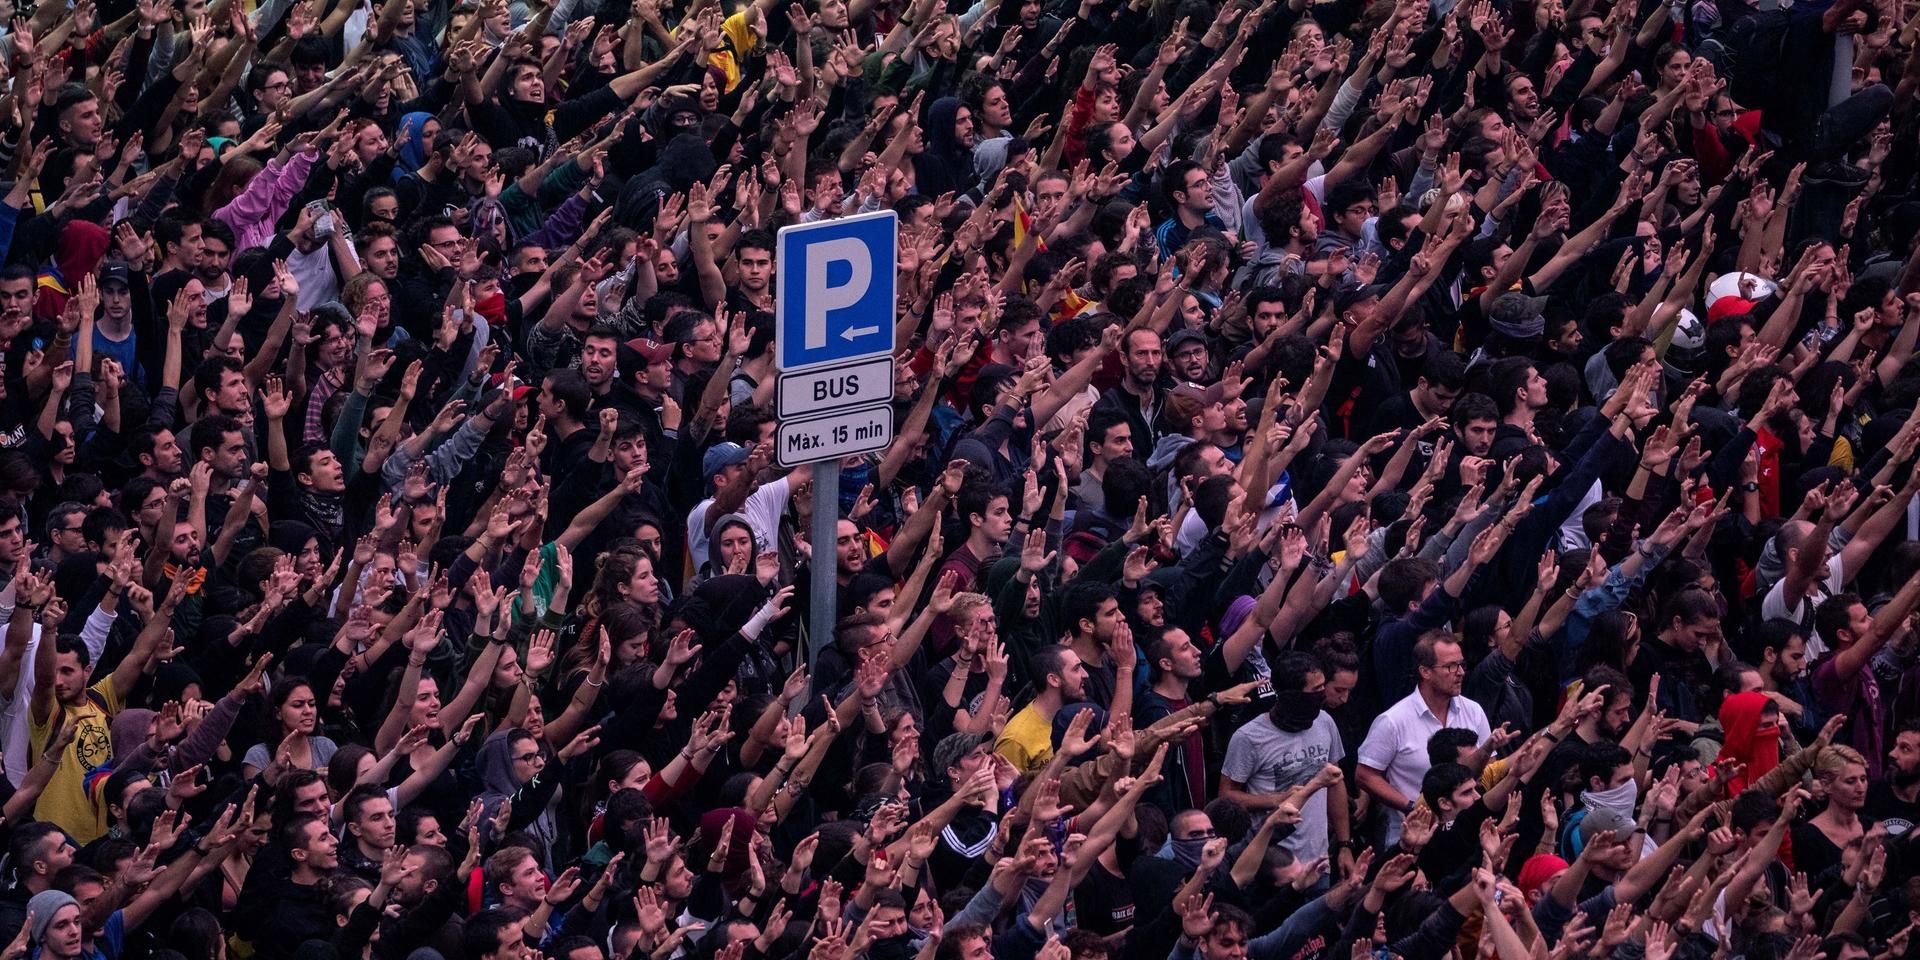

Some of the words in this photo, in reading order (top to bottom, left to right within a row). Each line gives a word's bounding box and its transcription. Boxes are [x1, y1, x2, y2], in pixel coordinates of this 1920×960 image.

[805, 237, 873, 350] P
[813, 374, 860, 401] BUS
[788, 433, 825, 453] Màx.
[832, 425, 848, 445] 15
[855, 420, 883, 441] min
